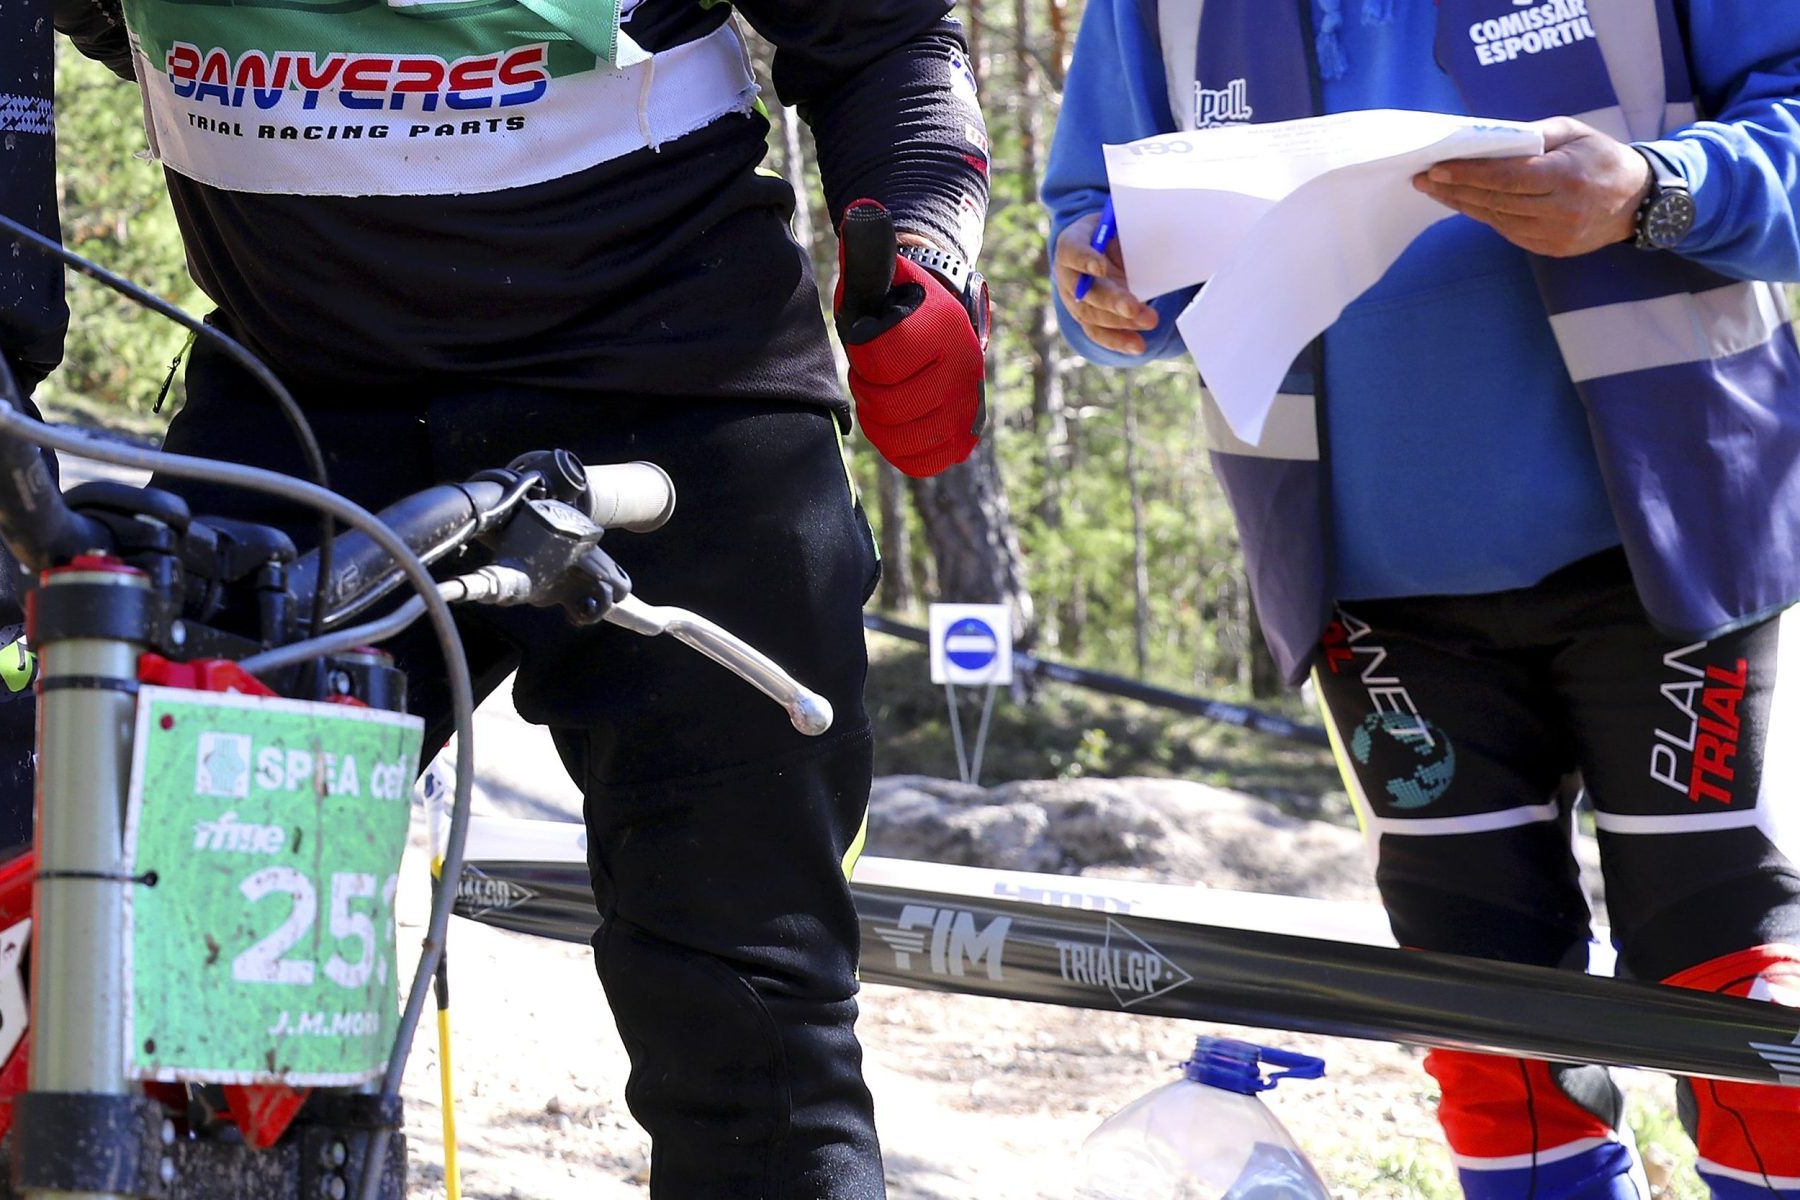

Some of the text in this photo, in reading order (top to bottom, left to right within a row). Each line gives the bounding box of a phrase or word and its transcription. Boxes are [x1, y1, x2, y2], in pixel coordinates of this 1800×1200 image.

[167, 43, 549, 113] BANYERES
[187, 112, 527, 140] TRIAL RACING PARTS
[1334, 604, 1435, 748] ANET
[1649, 640, 1709, 794] PLAN
[1687, 657, 1748, 805] TRIAL
[255, 746, 361, 798] SPEA
[194, 811, 287, 855] rfme
[874, 904, 1013, 982] FIM
[1055, 939, 1163, 994] TRIALGP
